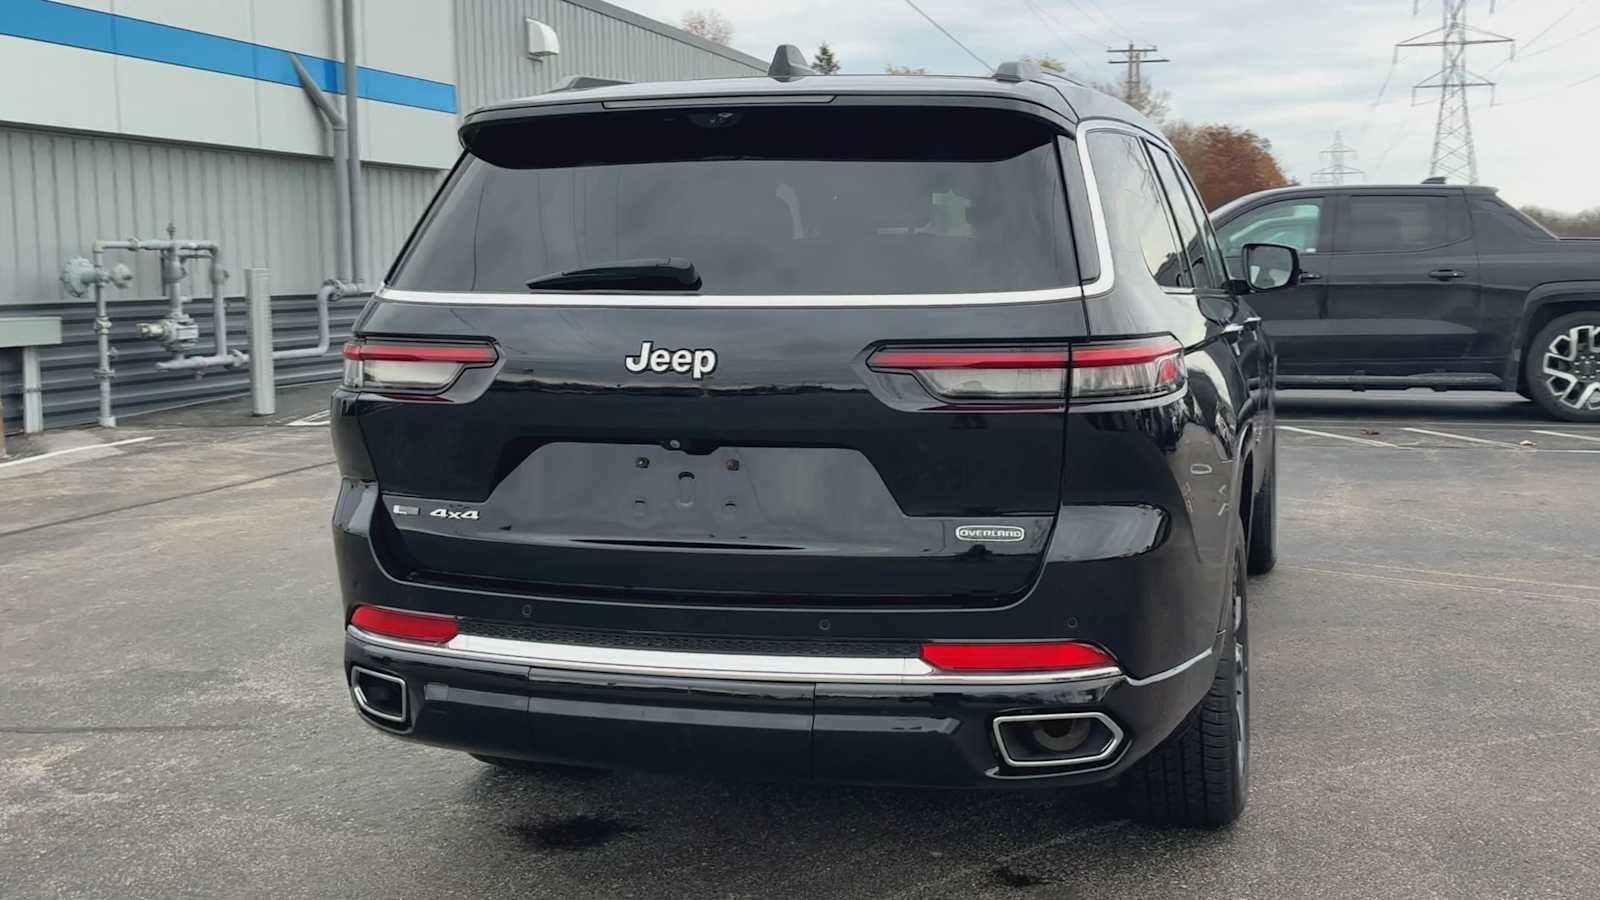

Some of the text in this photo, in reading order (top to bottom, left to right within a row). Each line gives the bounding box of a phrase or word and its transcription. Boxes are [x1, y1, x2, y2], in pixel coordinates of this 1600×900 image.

[625, 341, 717, 379] Jeep
[430, 508, 479, 519] 4x4
[958, 528, 1022, 538] OVERLAND
